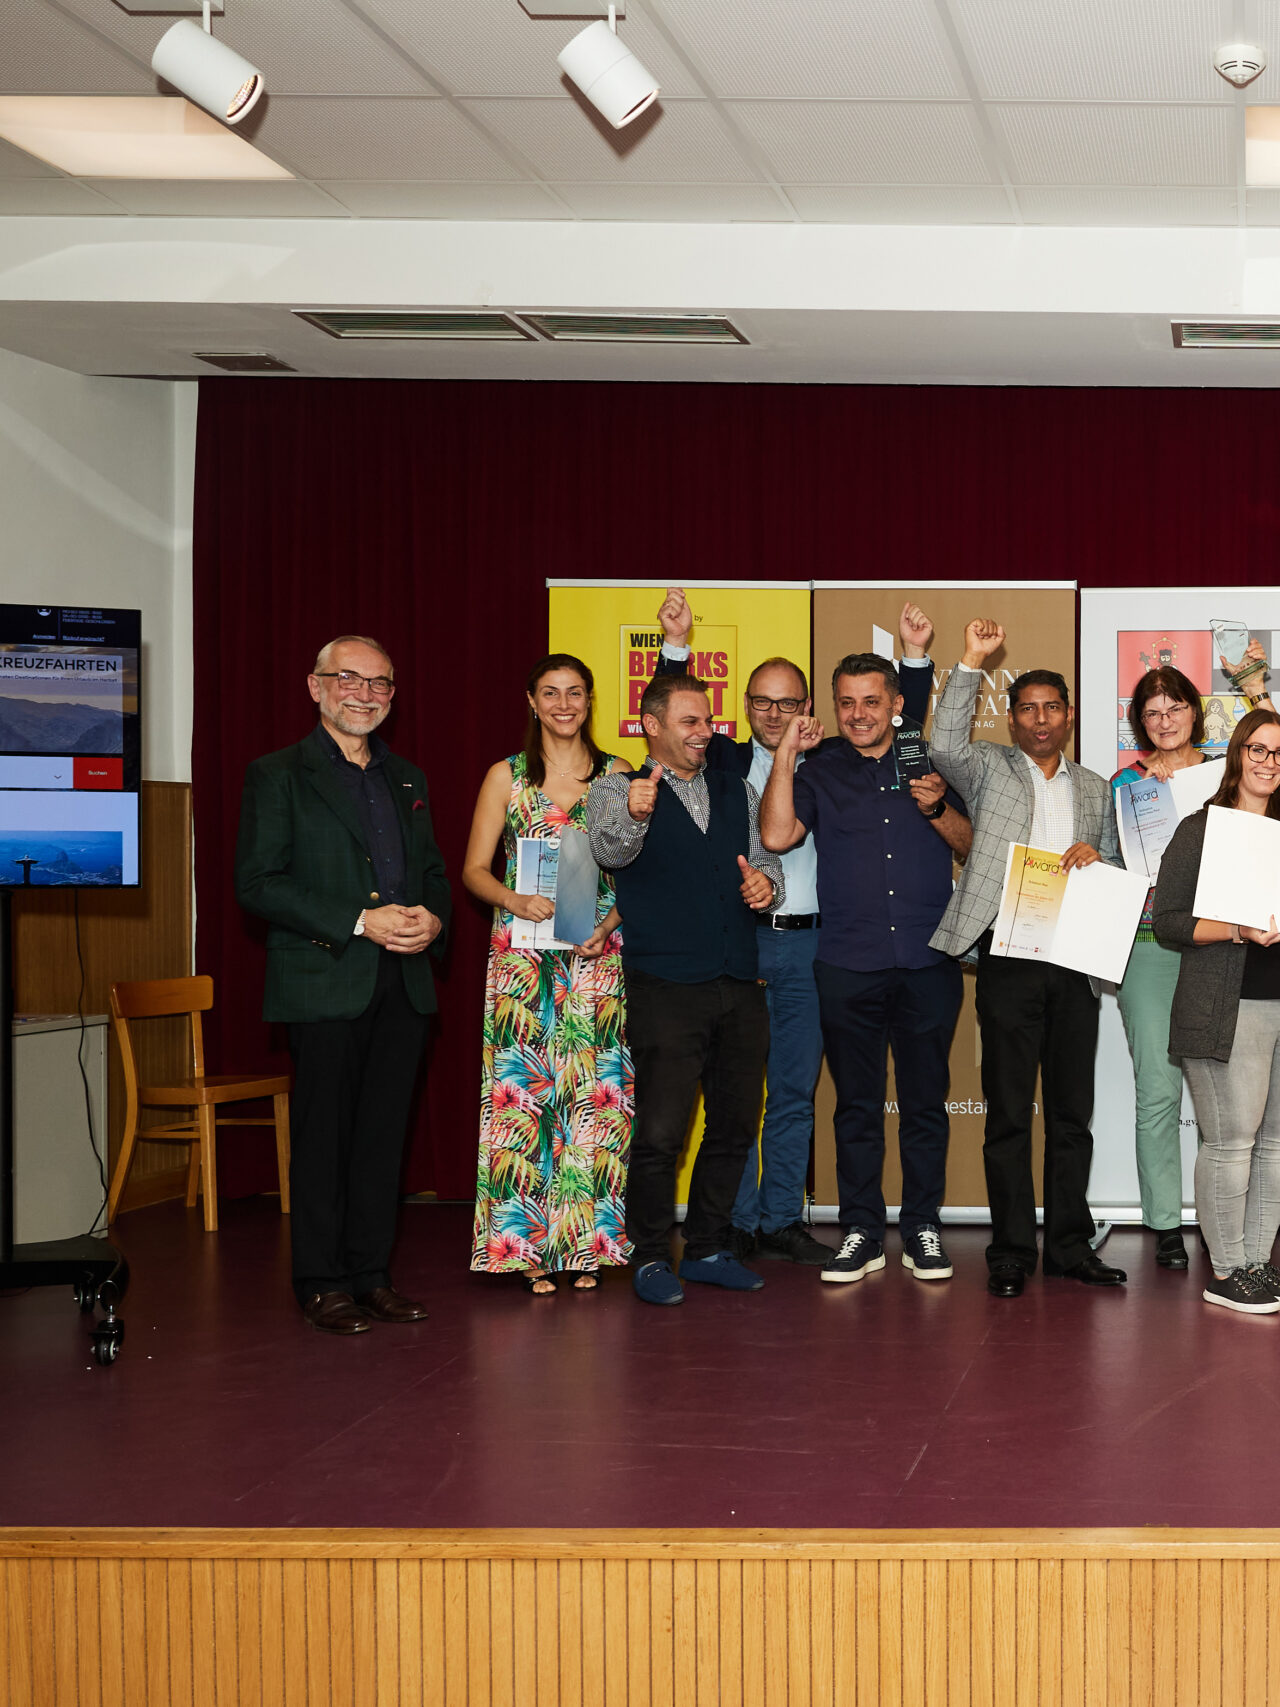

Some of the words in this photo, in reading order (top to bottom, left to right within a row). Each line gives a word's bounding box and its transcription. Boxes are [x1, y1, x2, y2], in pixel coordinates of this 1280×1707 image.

[694, 614, 703, 622] by
[630, 633, 665, 648] WIEN
[983, 720, 996, 728] AG
[1024, 856, 1061, 874] Award
